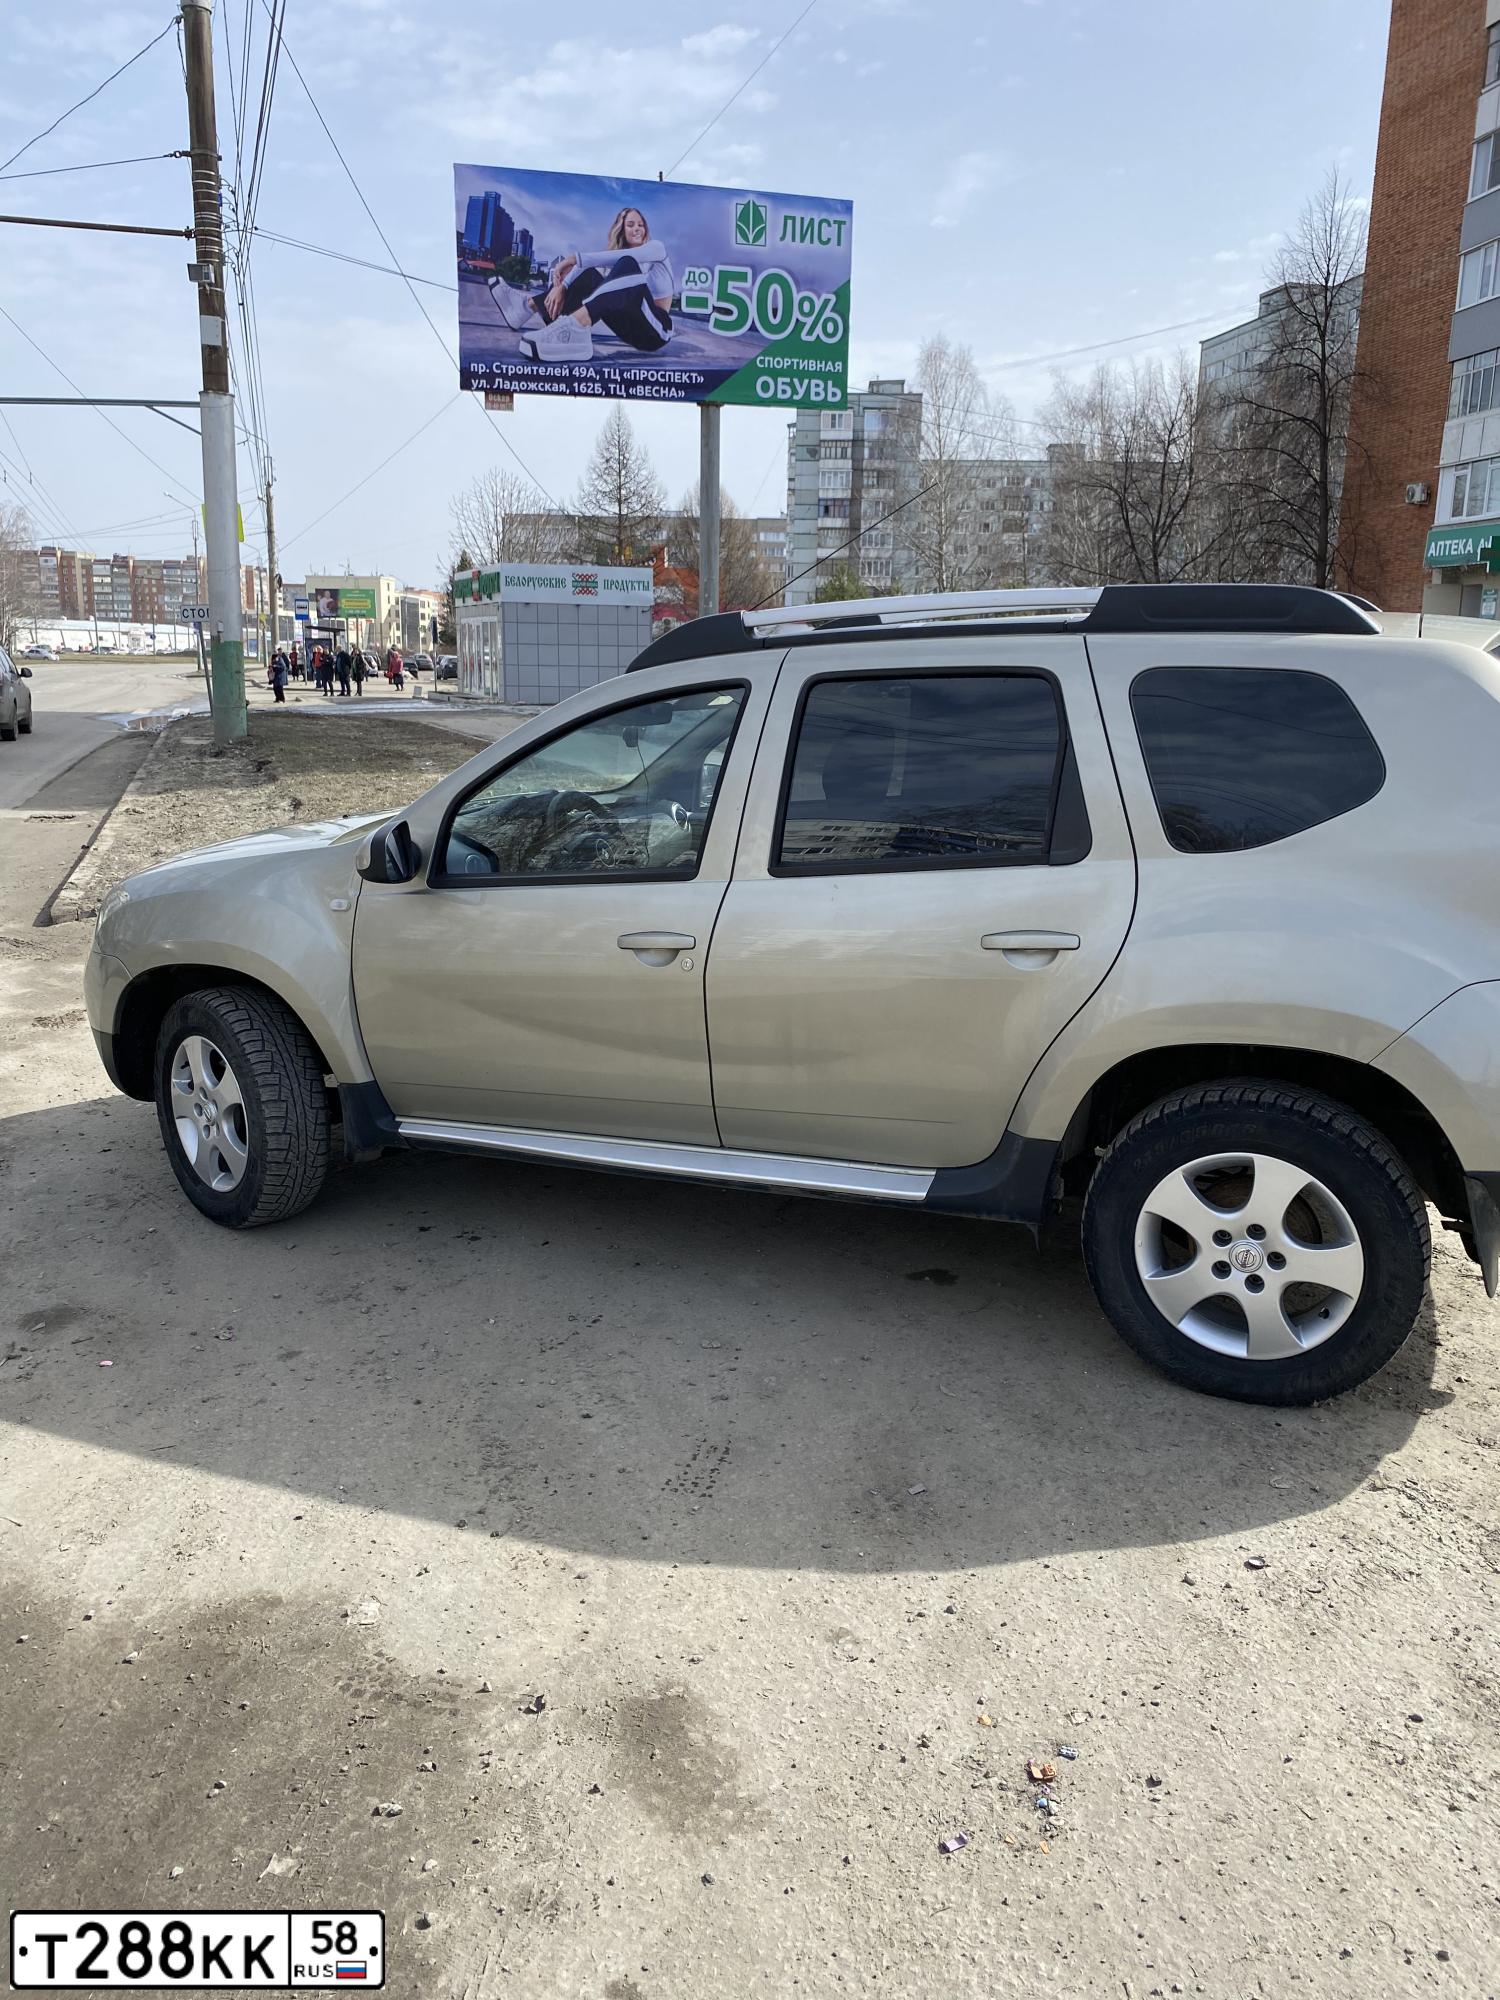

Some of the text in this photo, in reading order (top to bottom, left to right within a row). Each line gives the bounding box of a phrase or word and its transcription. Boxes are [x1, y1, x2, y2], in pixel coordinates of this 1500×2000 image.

[779, 215, 846, 247] ЛИСТ
[682, 266, 842, 342] -50%
[470, 362, 704, 384] пр. Строителей 49А, ТЦ «ПРОСПЕКТ»
[756, 356, 843, 373] СПОРТИВНАЯ
[471, 378, 685, 399] ул. Ладожская, 162Б, ТЦ «ВЕСНА»
[755, 376, 842, 402] ОБУВЬ
[1428, 538, 1473, 557] АПТЕКА
[505, 575, 567, 591] БЕЛОРУССКИЕ
[603, 579, 650, 593] ПРОДУКТЫ
